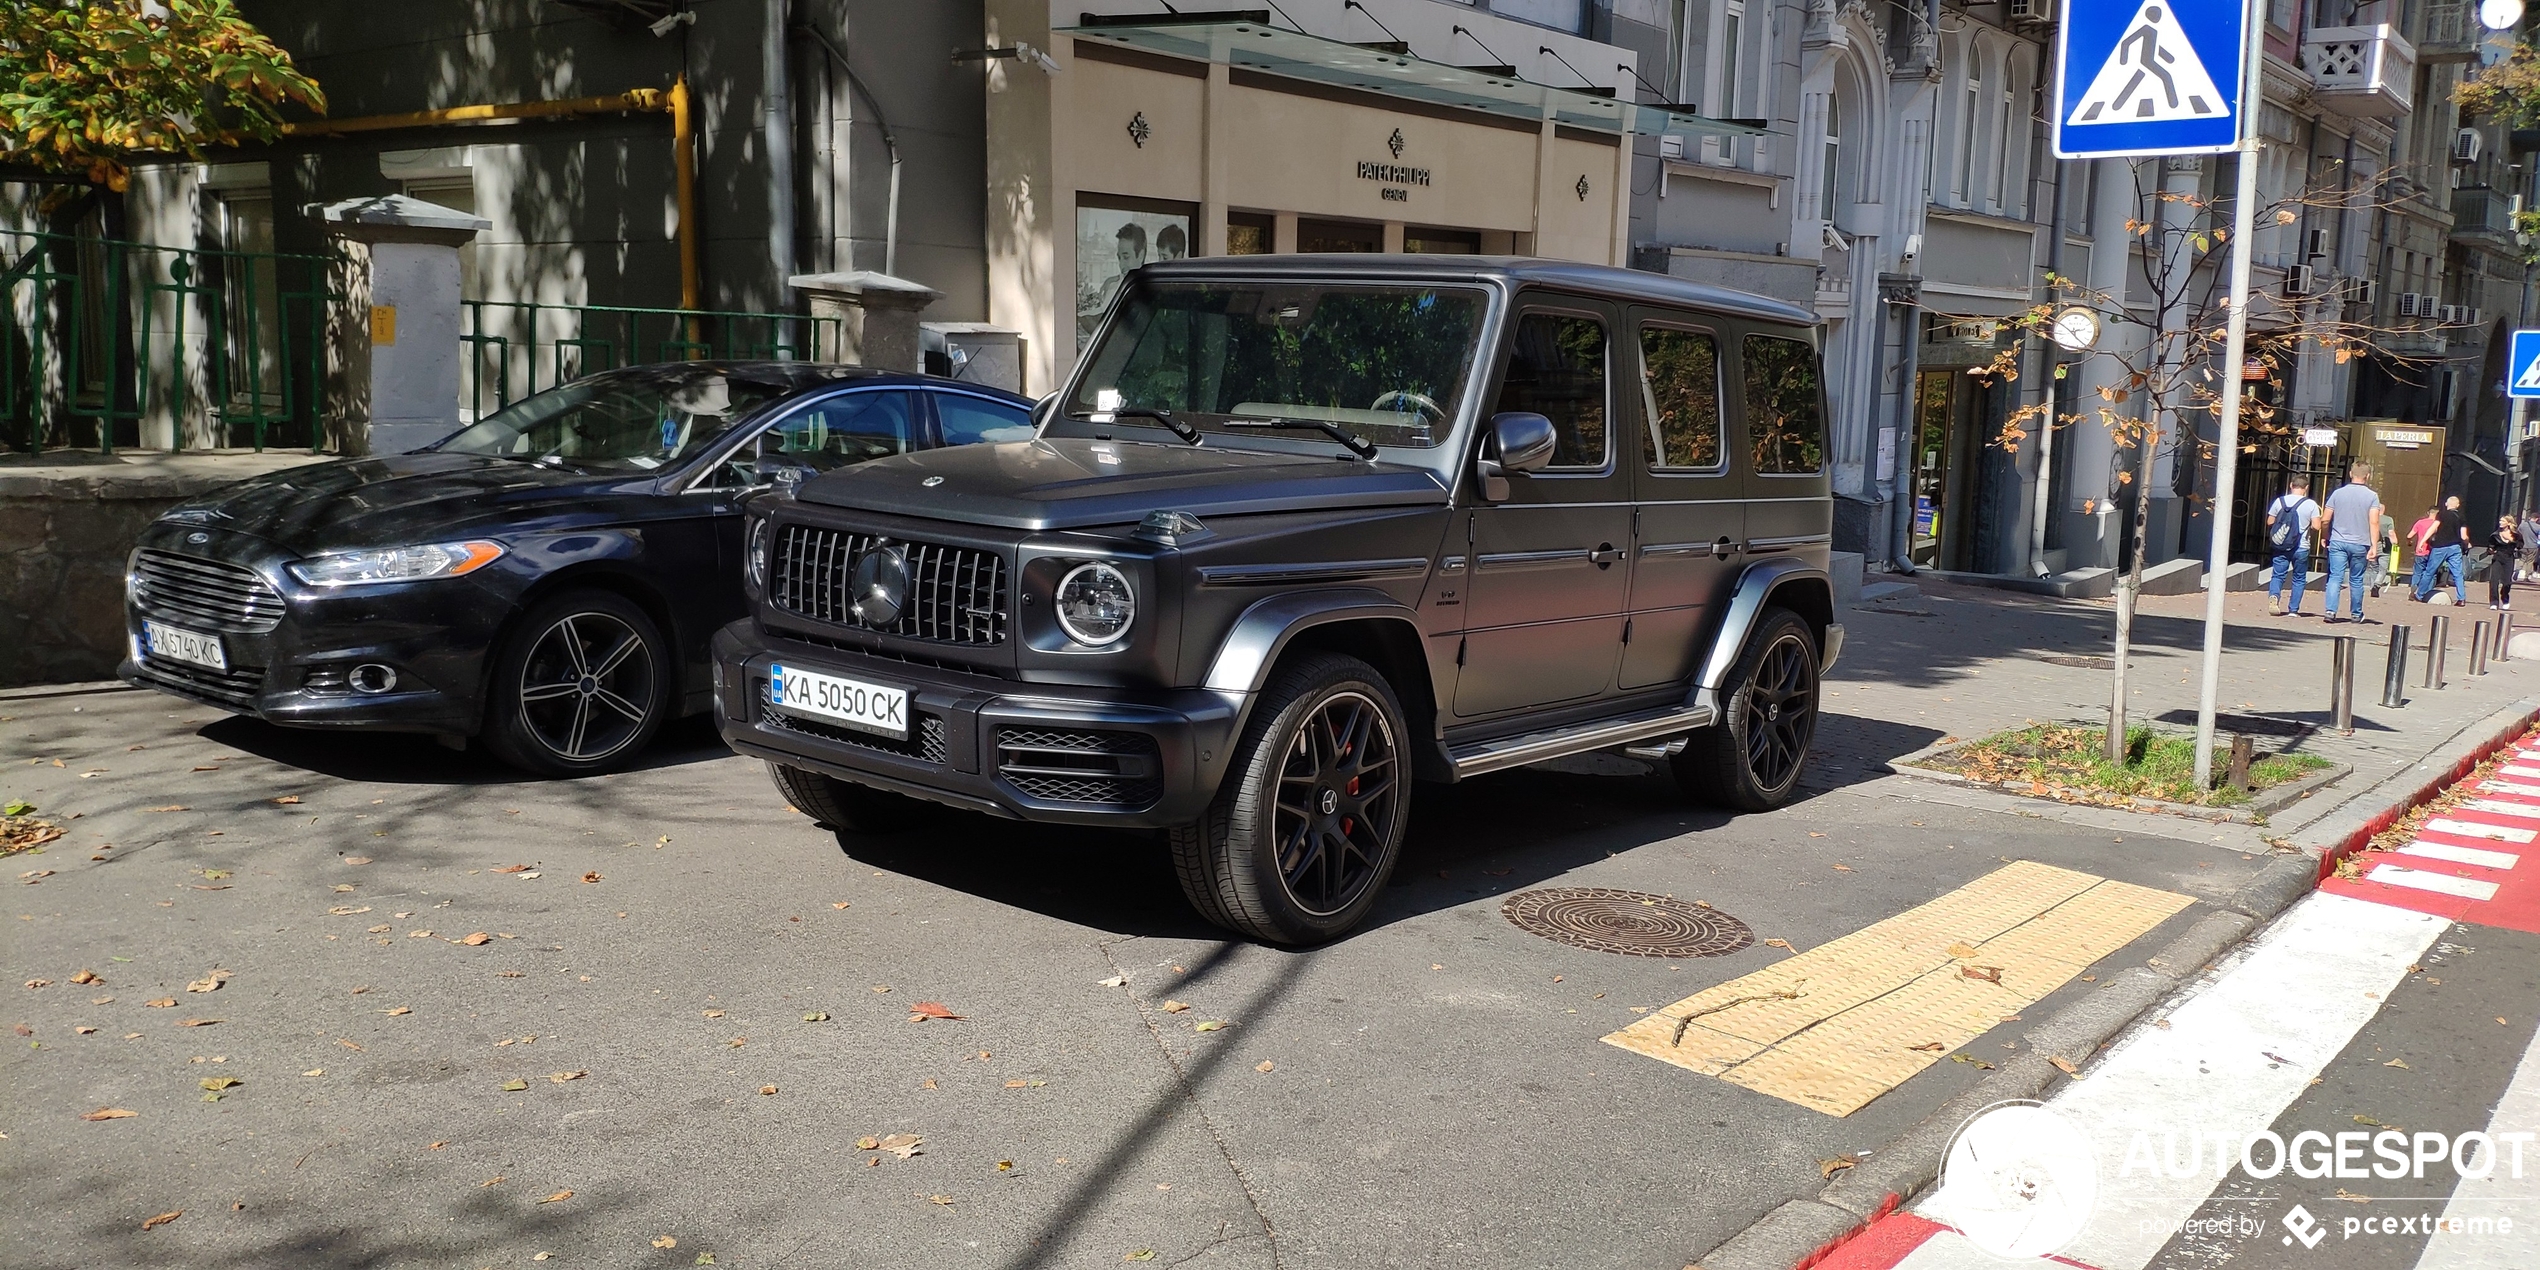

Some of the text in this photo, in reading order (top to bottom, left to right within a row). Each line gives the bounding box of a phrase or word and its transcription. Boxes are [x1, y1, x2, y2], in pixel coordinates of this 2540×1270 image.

[1358, 161, 1431, 187] PATEK PHILIPP
[1381, 188, 1408, 202] GENEV
[151, 628, 222, 664] AX 5740 KC
[773, 689, 782, 699] UA
[783, 672, 903, 725] KA 5050 CK
